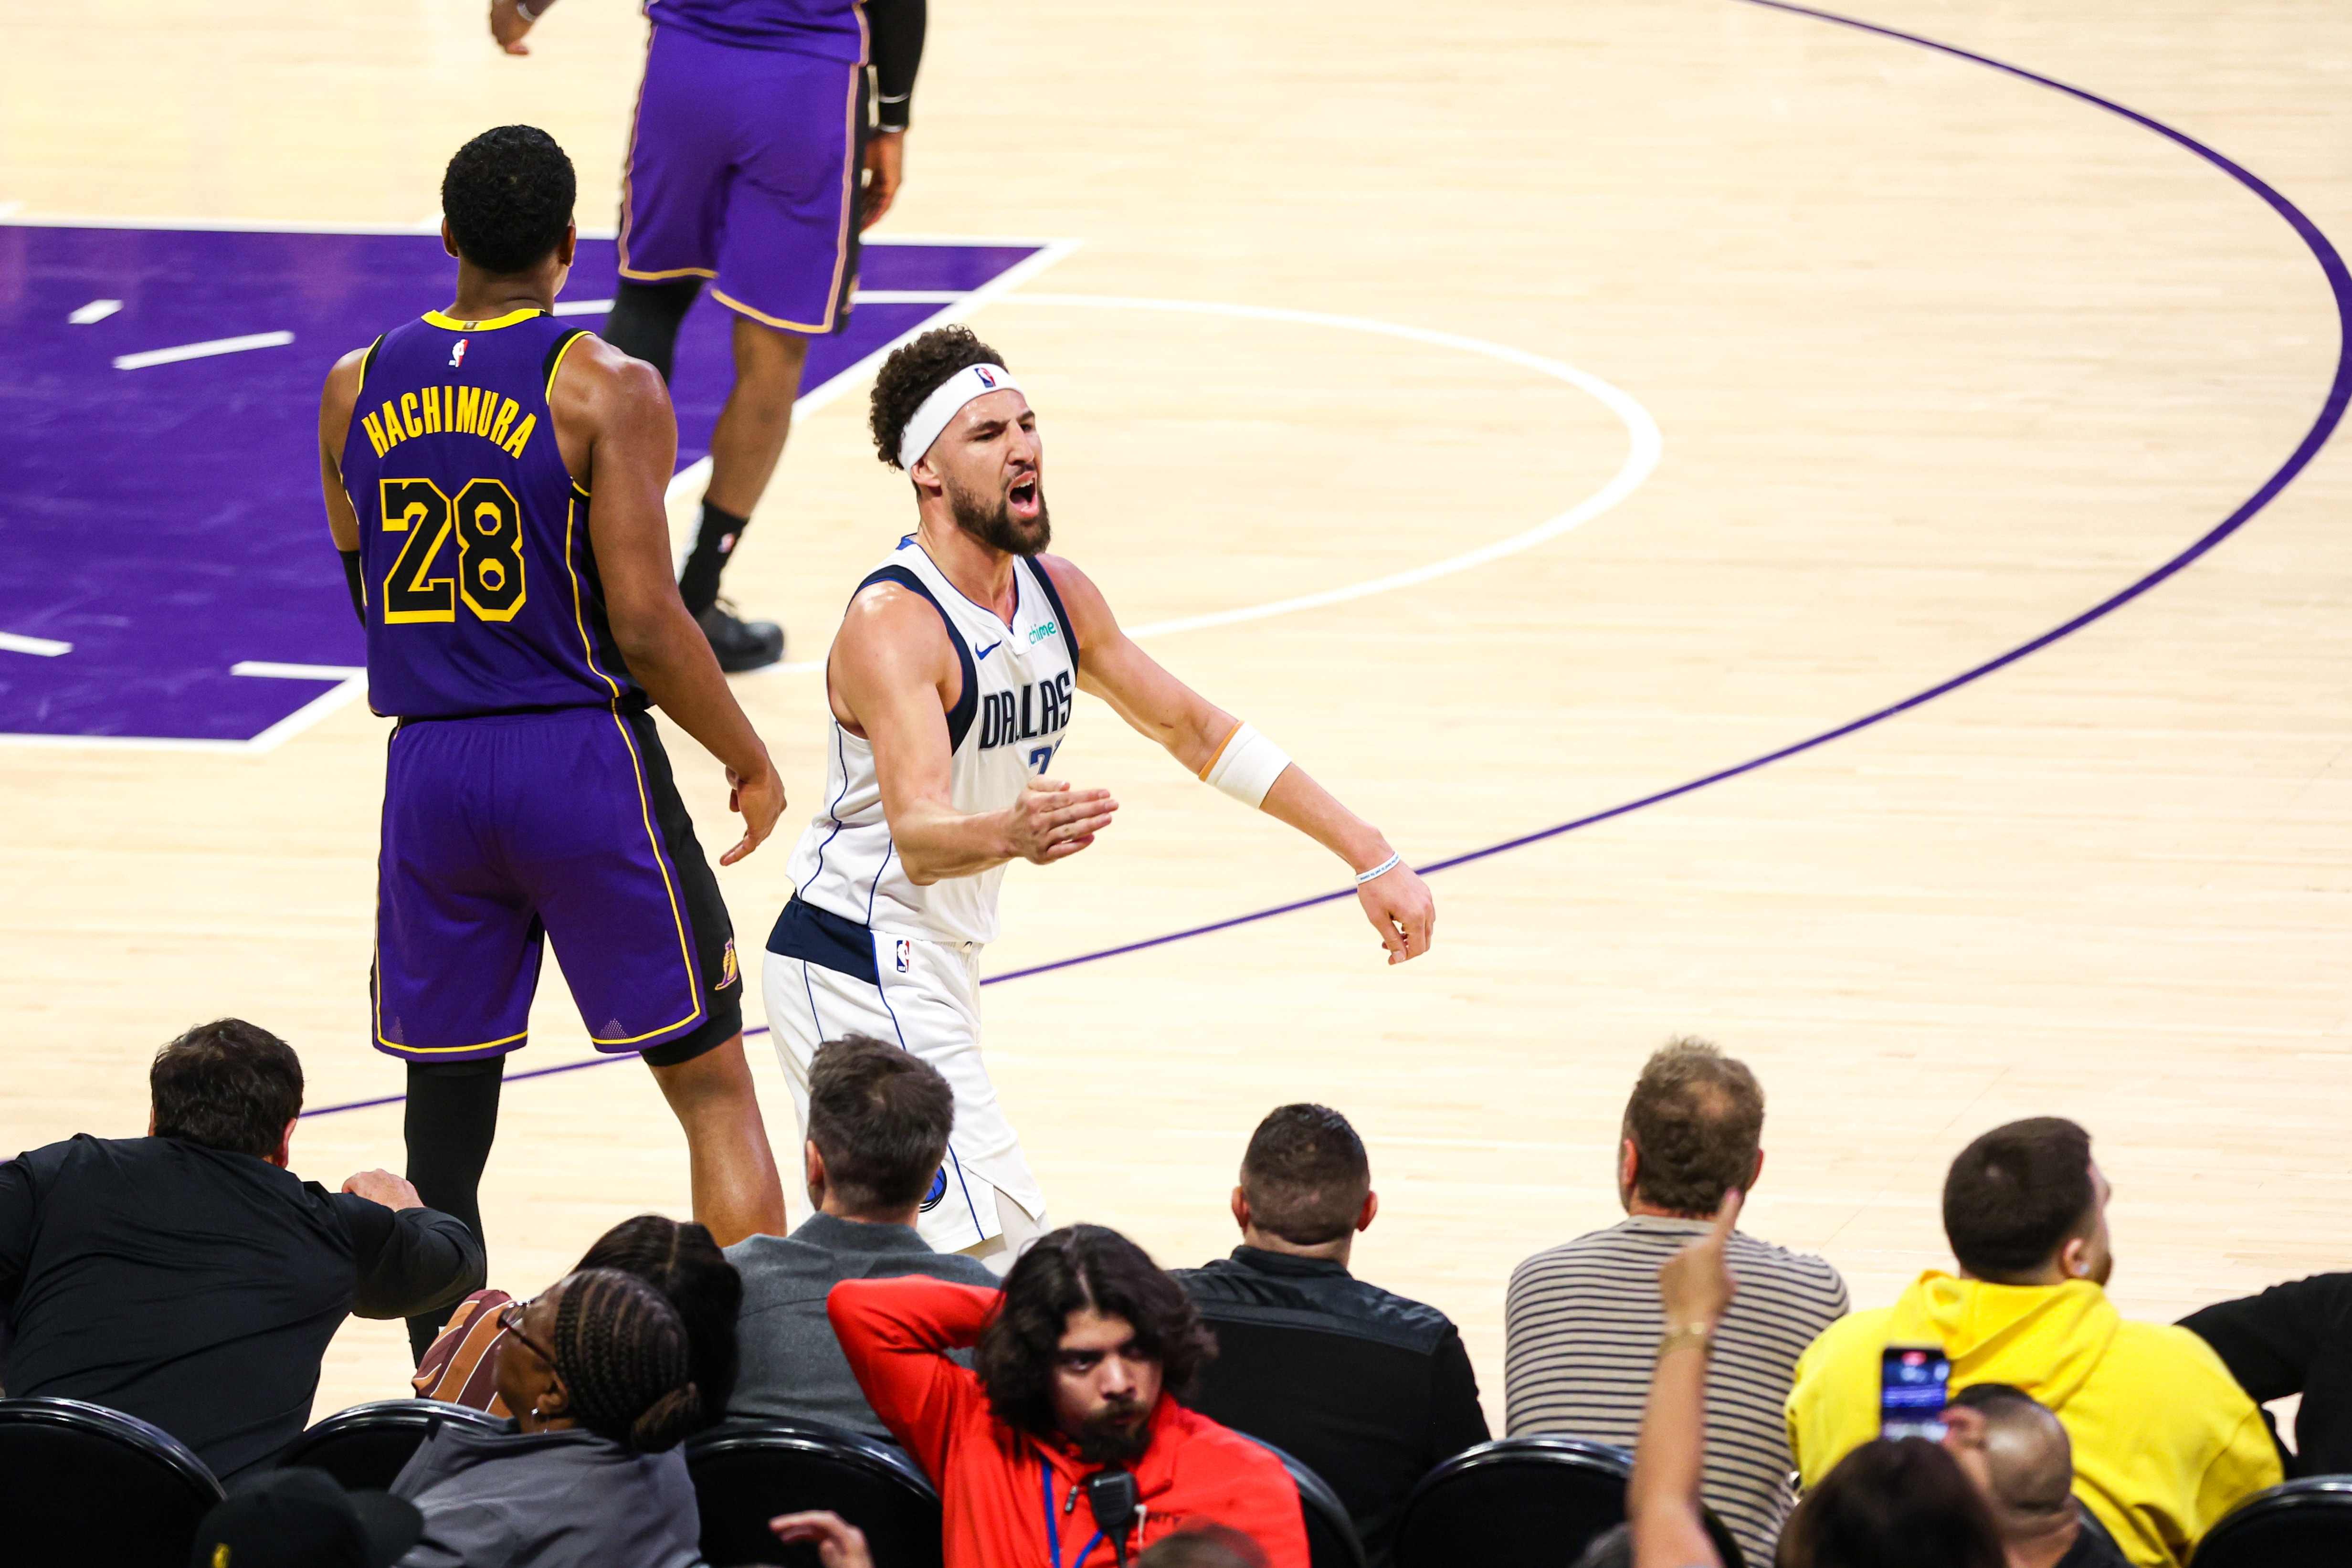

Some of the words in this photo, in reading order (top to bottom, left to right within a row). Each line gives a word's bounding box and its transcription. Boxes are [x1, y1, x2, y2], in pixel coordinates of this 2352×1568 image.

[361, 386, 537, 459] HACHIMURA
[379, 478, 527, 624] 28
[1029, 621, 1056, 645] chime
[978, 668, 1072, 752] DALAS
